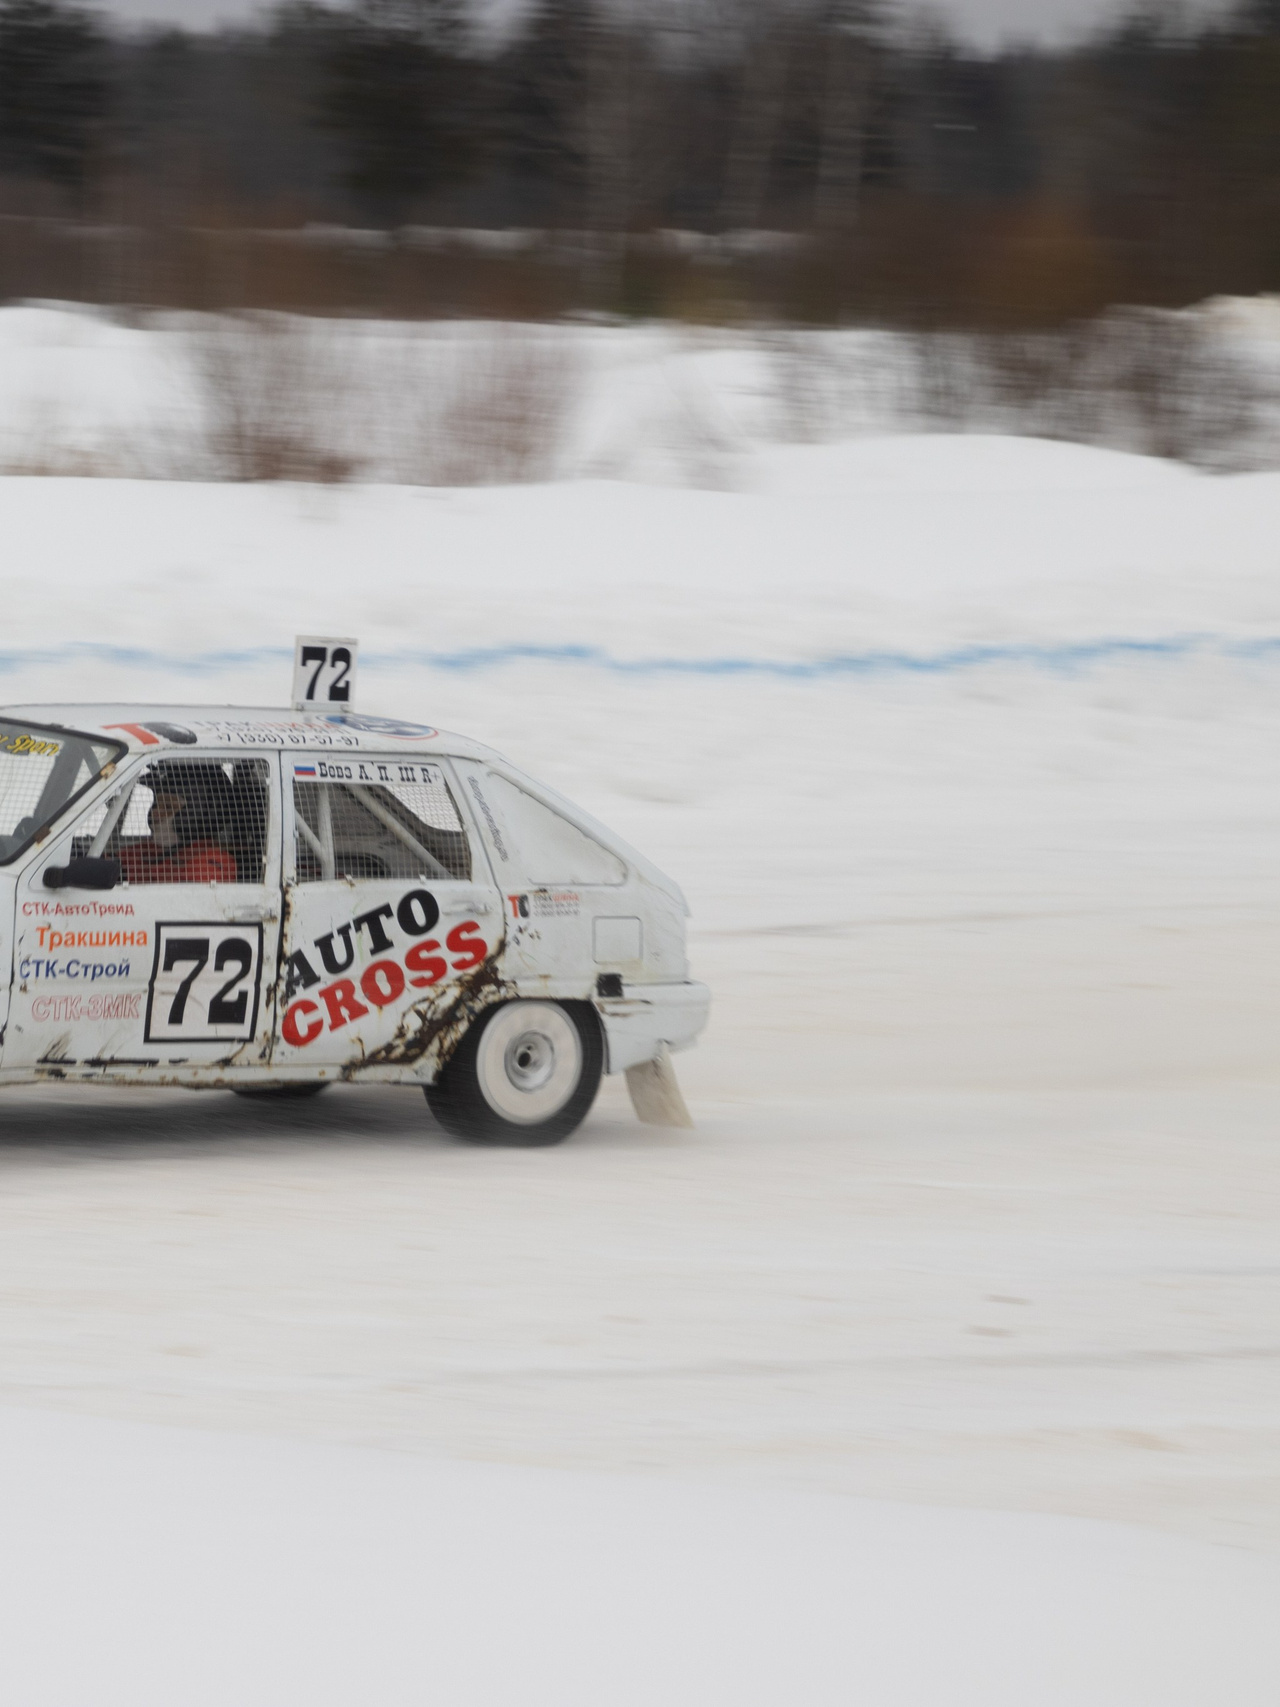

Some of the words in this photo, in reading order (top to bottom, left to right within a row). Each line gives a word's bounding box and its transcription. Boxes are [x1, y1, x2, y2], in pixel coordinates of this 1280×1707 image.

[301, 646, 351, 701] 72
[19, 958, 131, 981] СТК-Строй
[36, 926, 148, 951] Тракшина
[285, 888, 439, 999] AUTO
[162, 937, 253, 1025] 72
[282, 920, 488, 1047] CROSS
